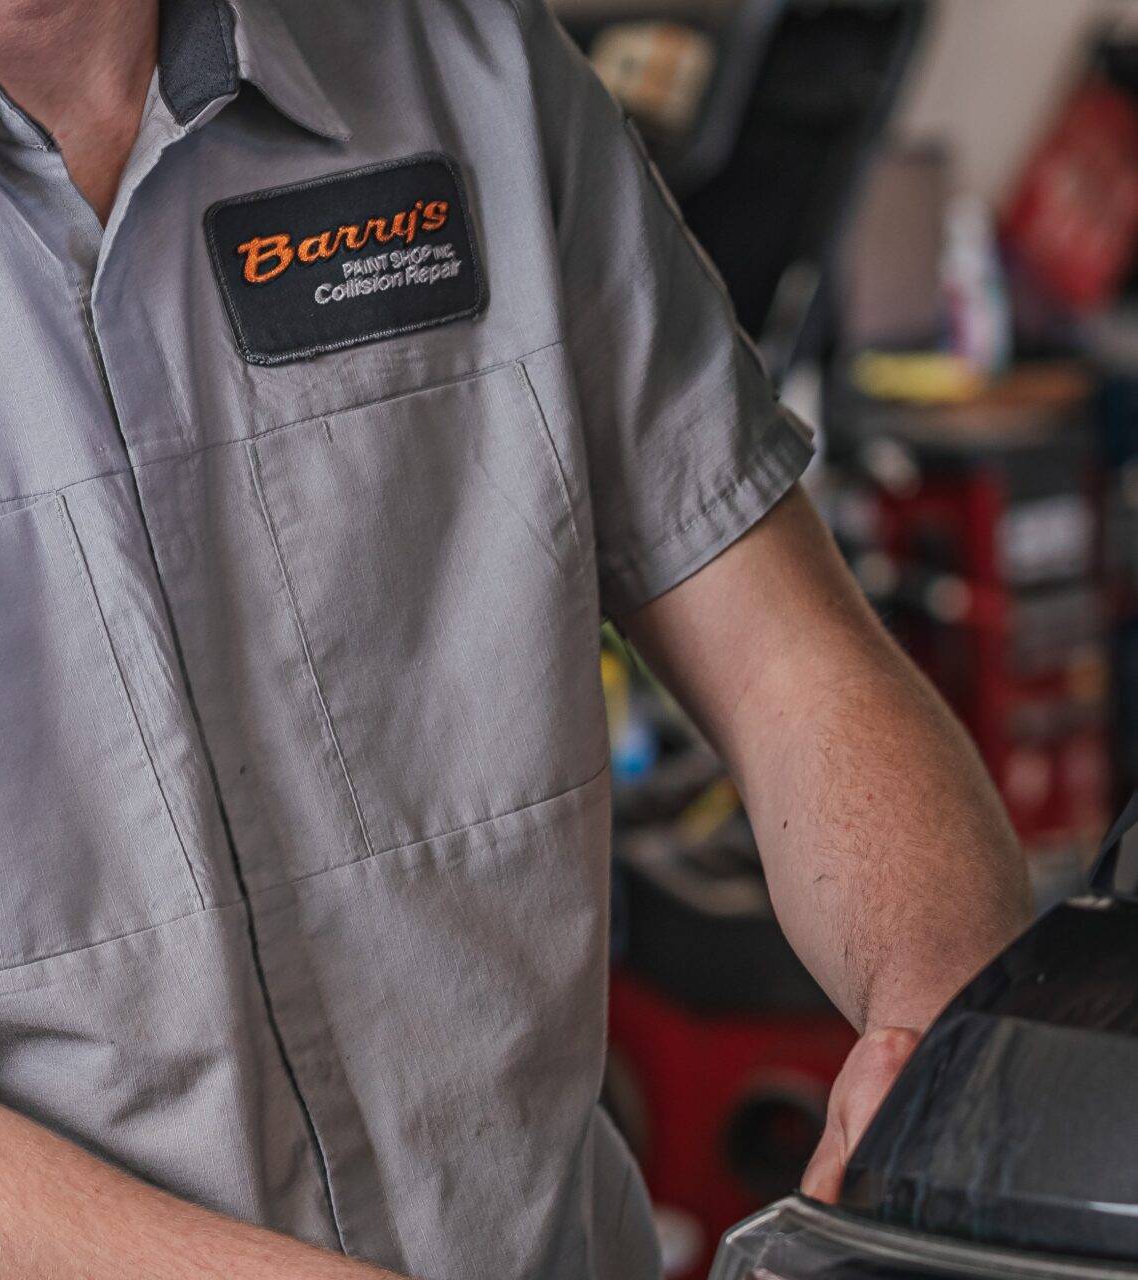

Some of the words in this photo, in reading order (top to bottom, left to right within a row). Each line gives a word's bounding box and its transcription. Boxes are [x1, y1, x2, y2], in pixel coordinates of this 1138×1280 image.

[237, 199, 449, 283] Barry's
[342, 253, 389, 278] PAINT
[390, 244, 432, 269] SHOP
[314, 270, 404, 305] Collision
[405, 258, 462, 286] Repair
